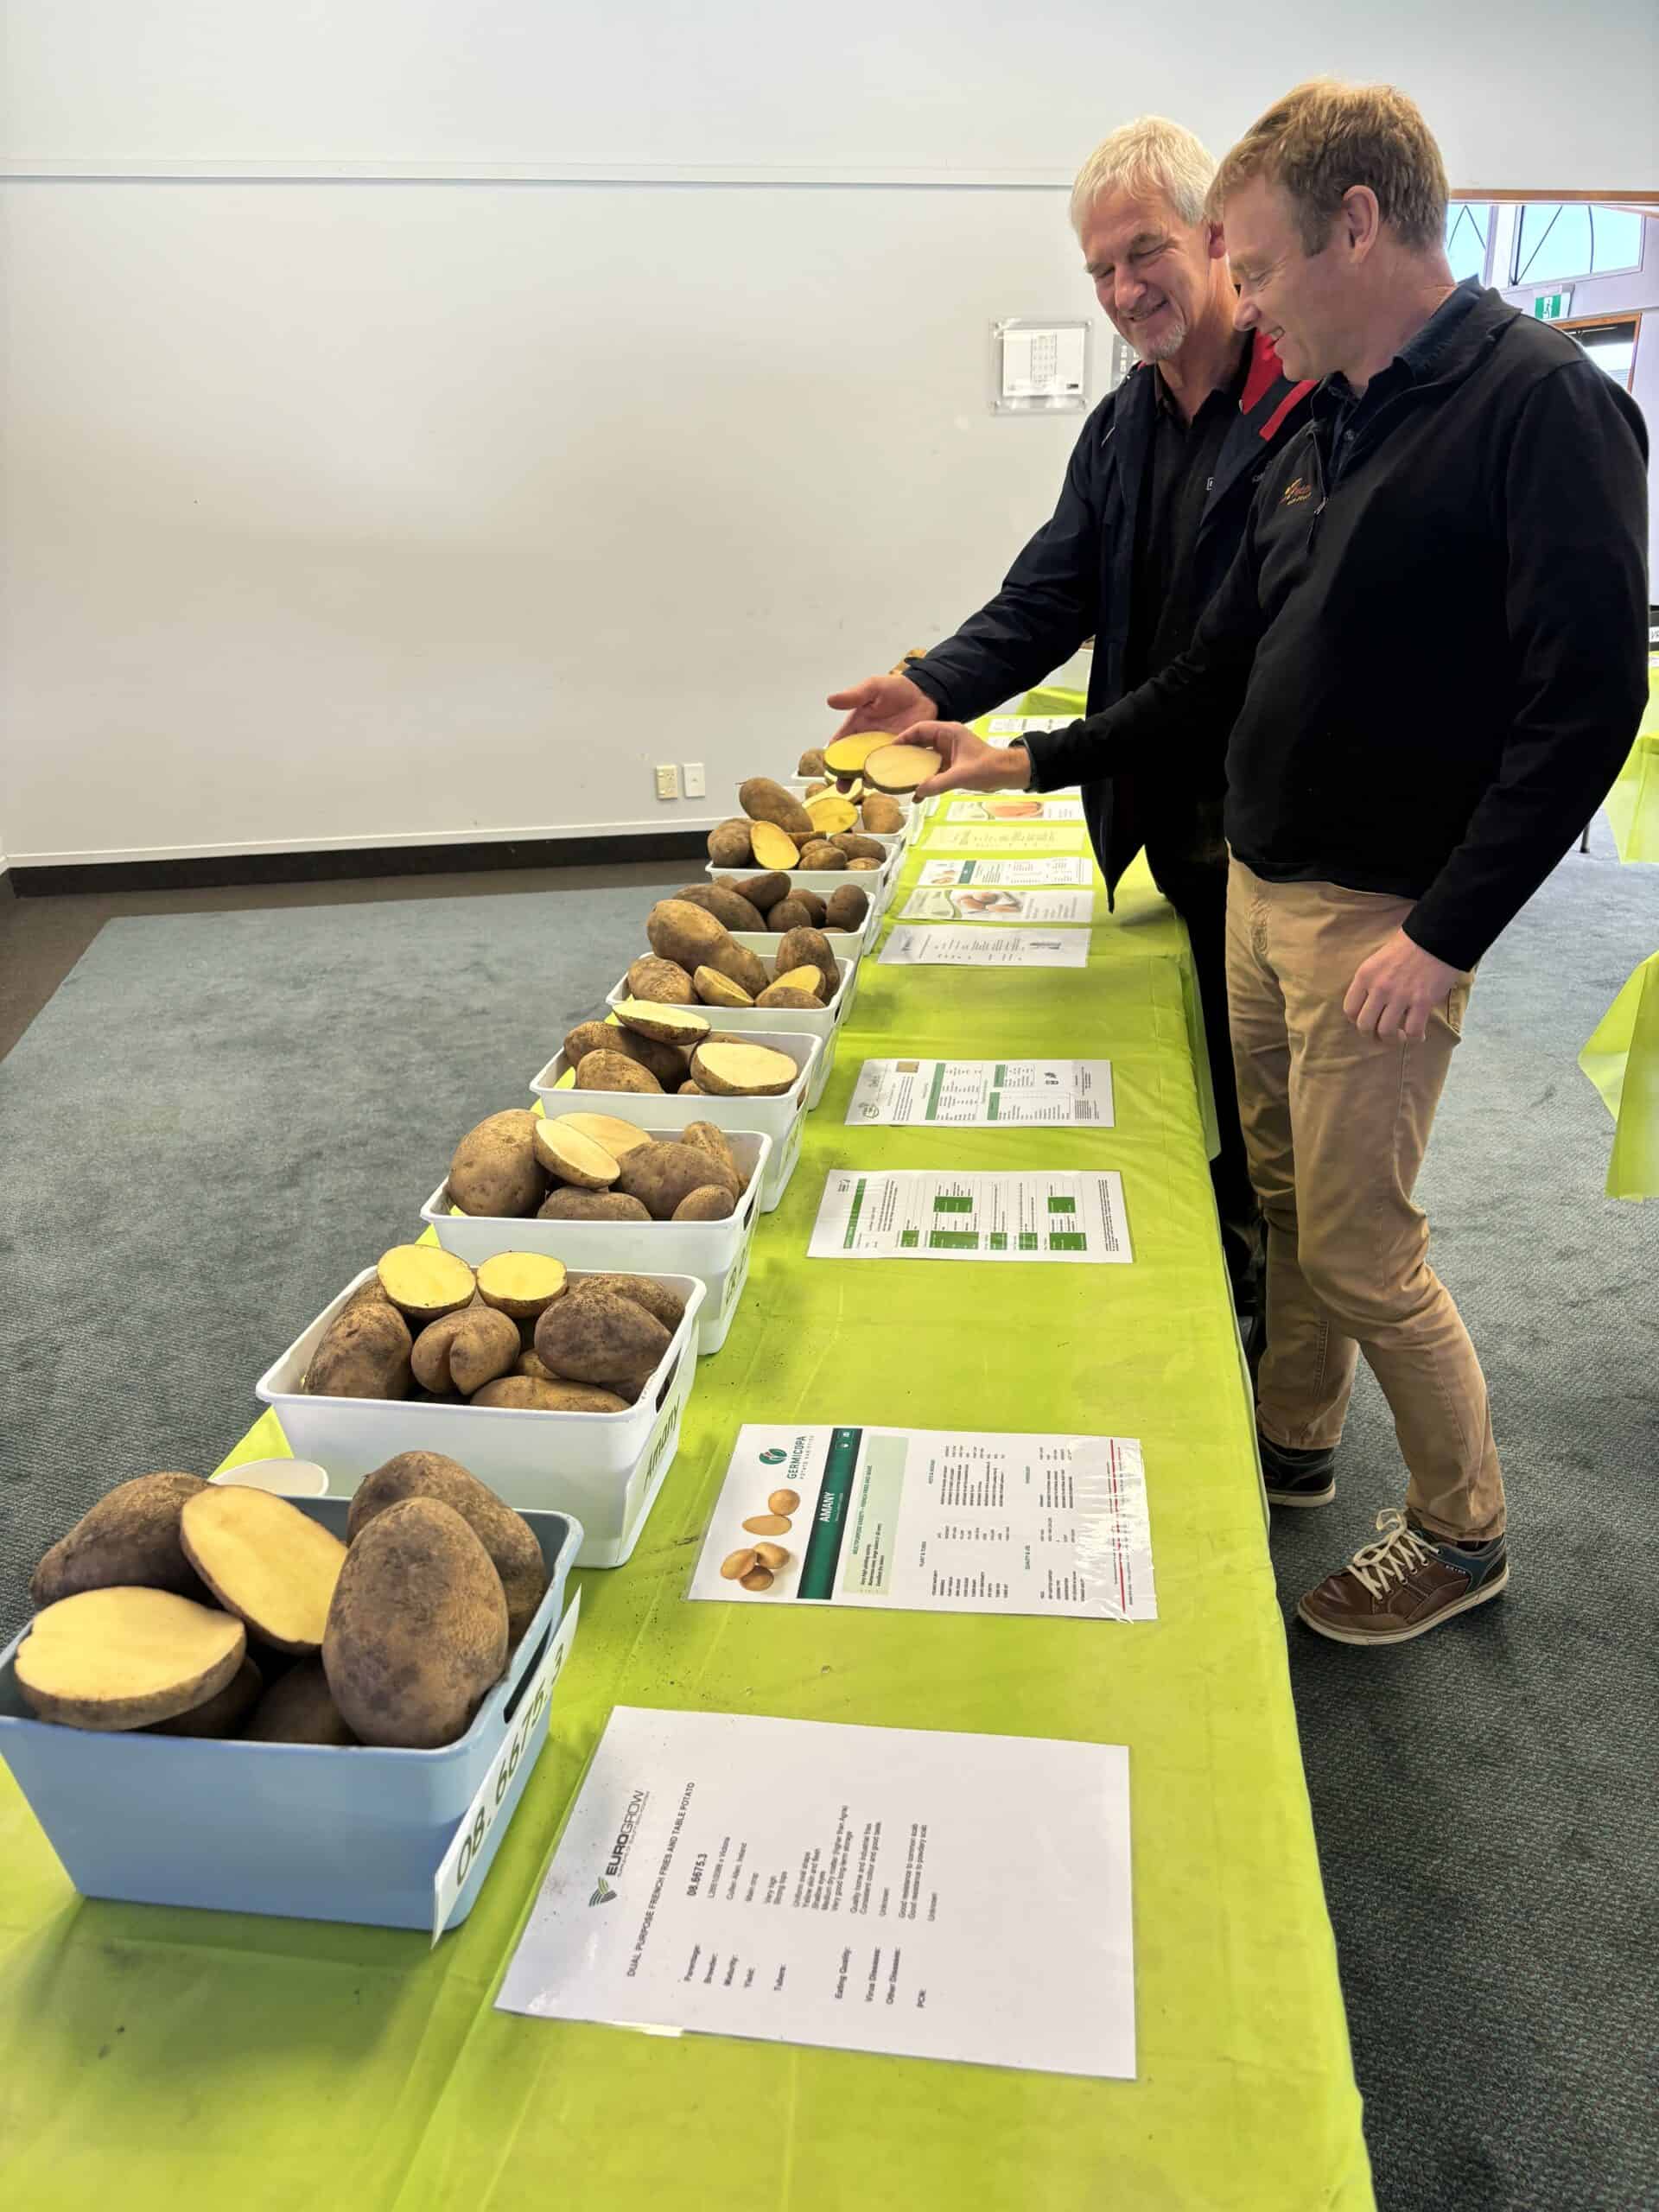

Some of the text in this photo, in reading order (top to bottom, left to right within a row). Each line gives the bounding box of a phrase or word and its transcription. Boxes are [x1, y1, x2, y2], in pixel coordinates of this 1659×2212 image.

[785, 1435, 806, 1479] GERMICOPA
[819, 1491, 835, 1522] AMANY
[605, 1789, 644, 1876] EUROGROW
[626, 1782, 695, 1977] DUAL PURPOSE FRENCH FRIES AND TABLE POTATO
[686, 1853, 708, 1897] 08.6675.3
[849, 1891, 861, 1914] Quality
[857, 1861, 866, 1872] and
[898, 1900, 908, 1918] Good
[906, 1837, 916, 1861] common
[907, 1901, 918, 1919] Good
[916, 1838, 926, 1863] powdery
[834, 1974, 847, 1999] Eating
[865, 1982, 875, 2002] Virus
[885, 1983, 896, 2005] Other
